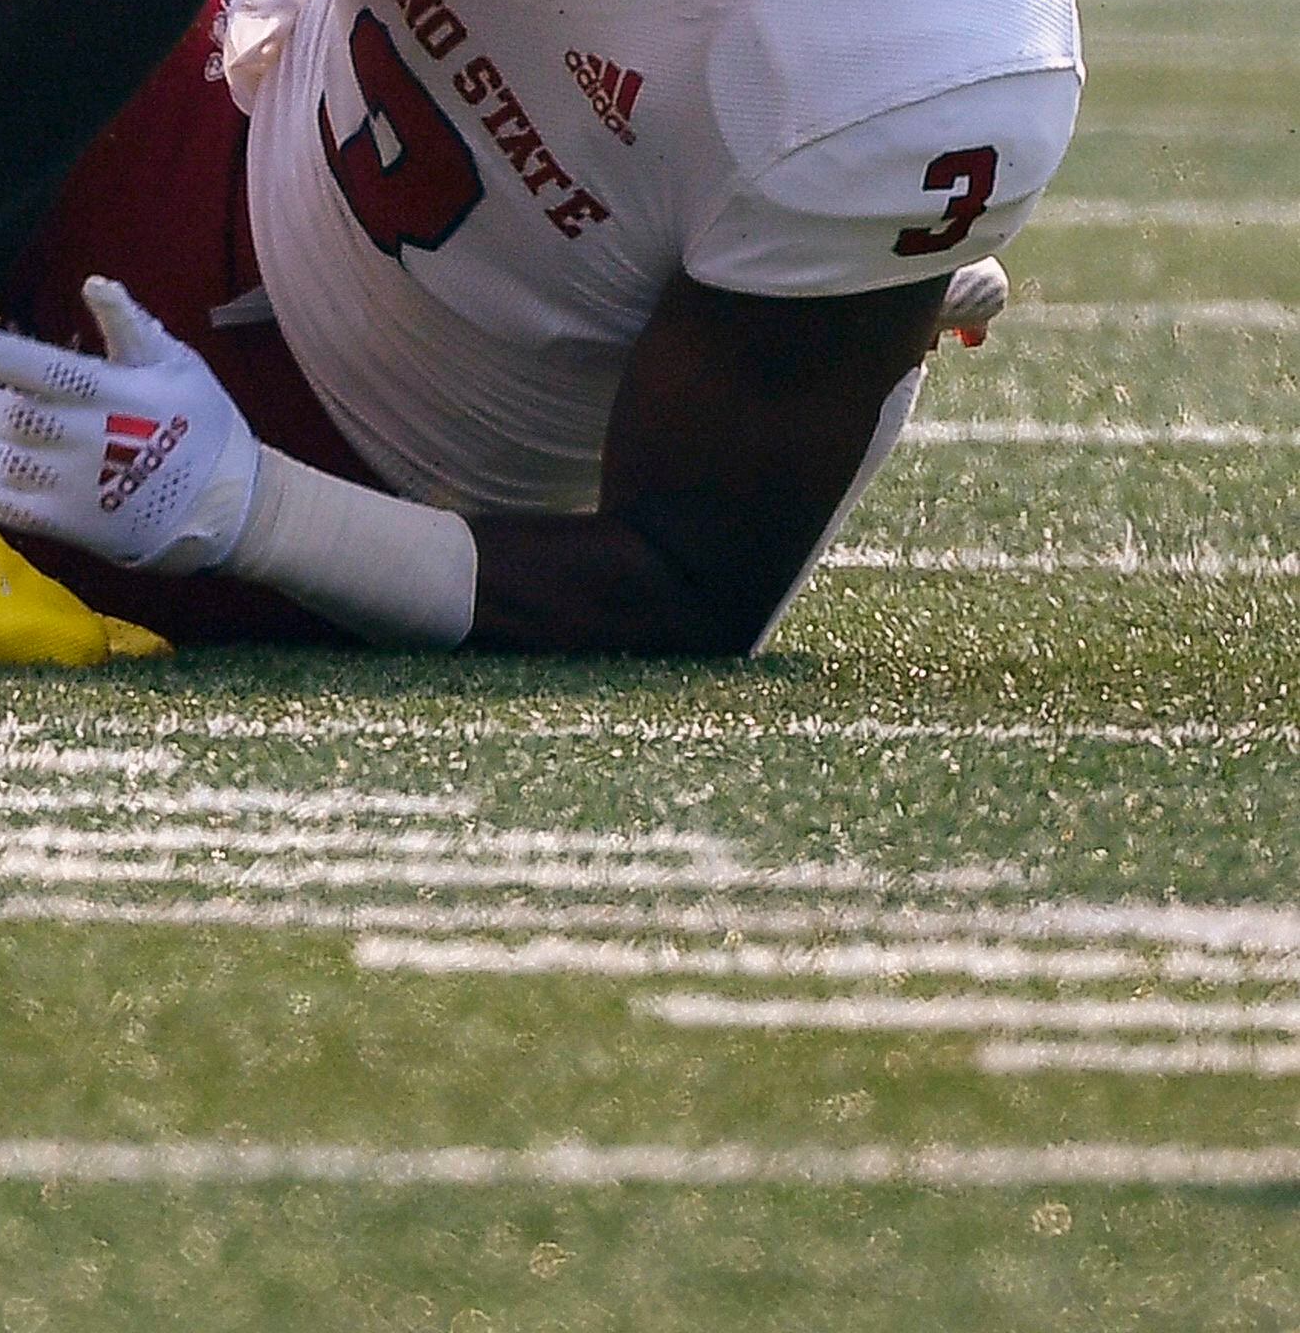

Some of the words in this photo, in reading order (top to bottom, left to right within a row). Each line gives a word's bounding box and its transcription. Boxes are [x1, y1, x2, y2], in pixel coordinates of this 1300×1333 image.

[453, 55, 611, 239] STATE
[564, 49, 636, 146] adidas
[893, 145, 999, 258] 3
[100, 414, 189, 512] adidas
